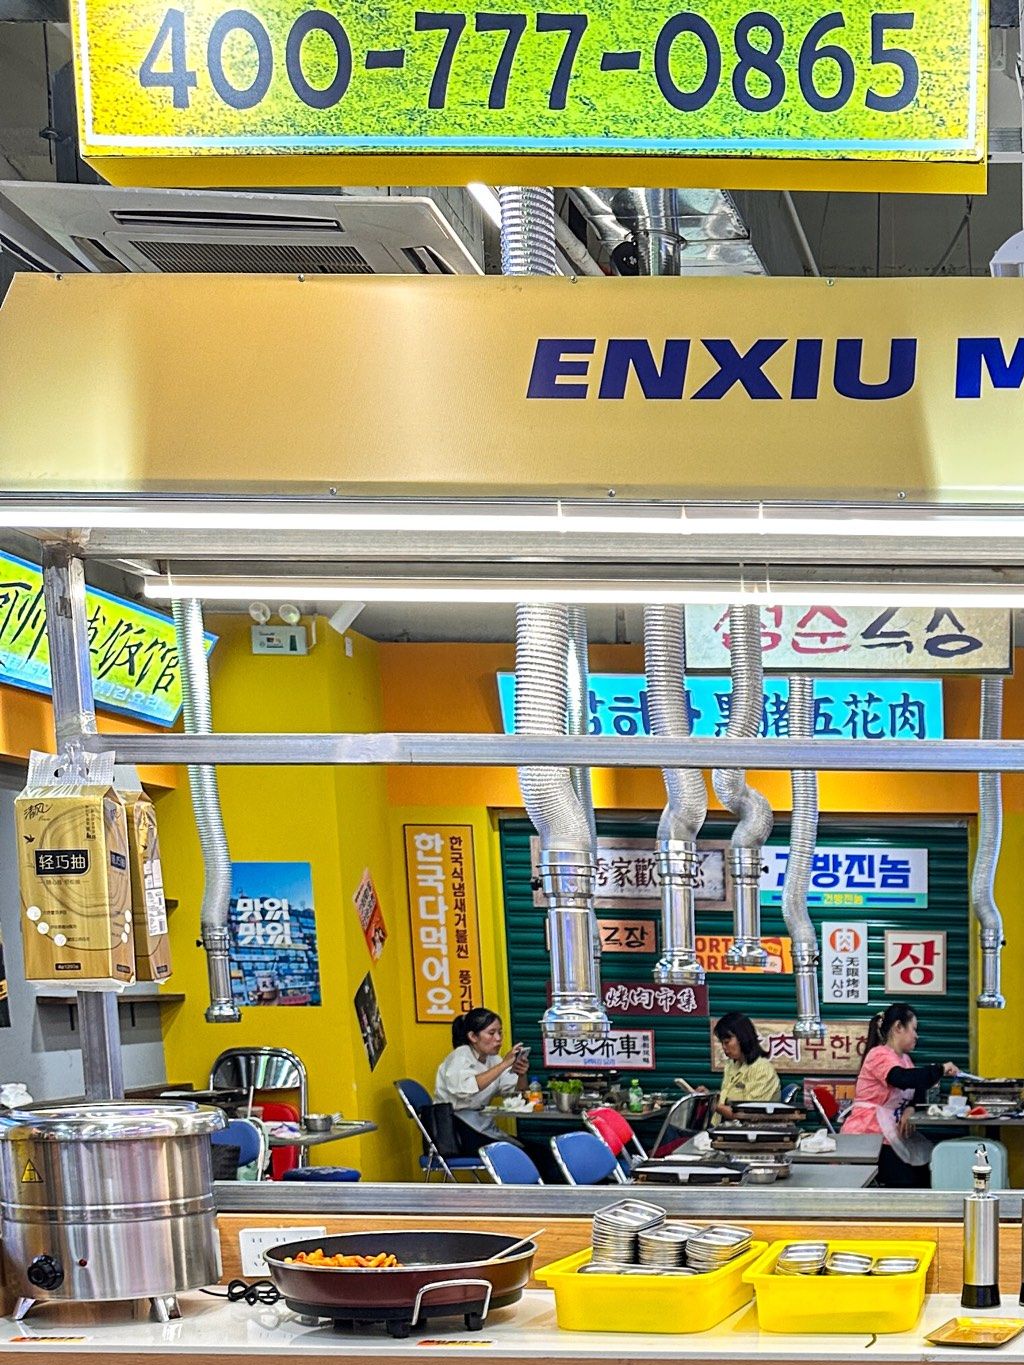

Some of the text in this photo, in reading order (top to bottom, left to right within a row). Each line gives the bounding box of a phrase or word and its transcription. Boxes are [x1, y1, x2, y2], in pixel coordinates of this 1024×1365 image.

[138, 10, 920, 113] 400-777-0865
[526, 338, 917, 399] ENXIU
[38, 854, 87, 870] 轻巧抽
[413, 832, 455, 1016] 한국다먹어요
[890, 939, 942, 986] 장
